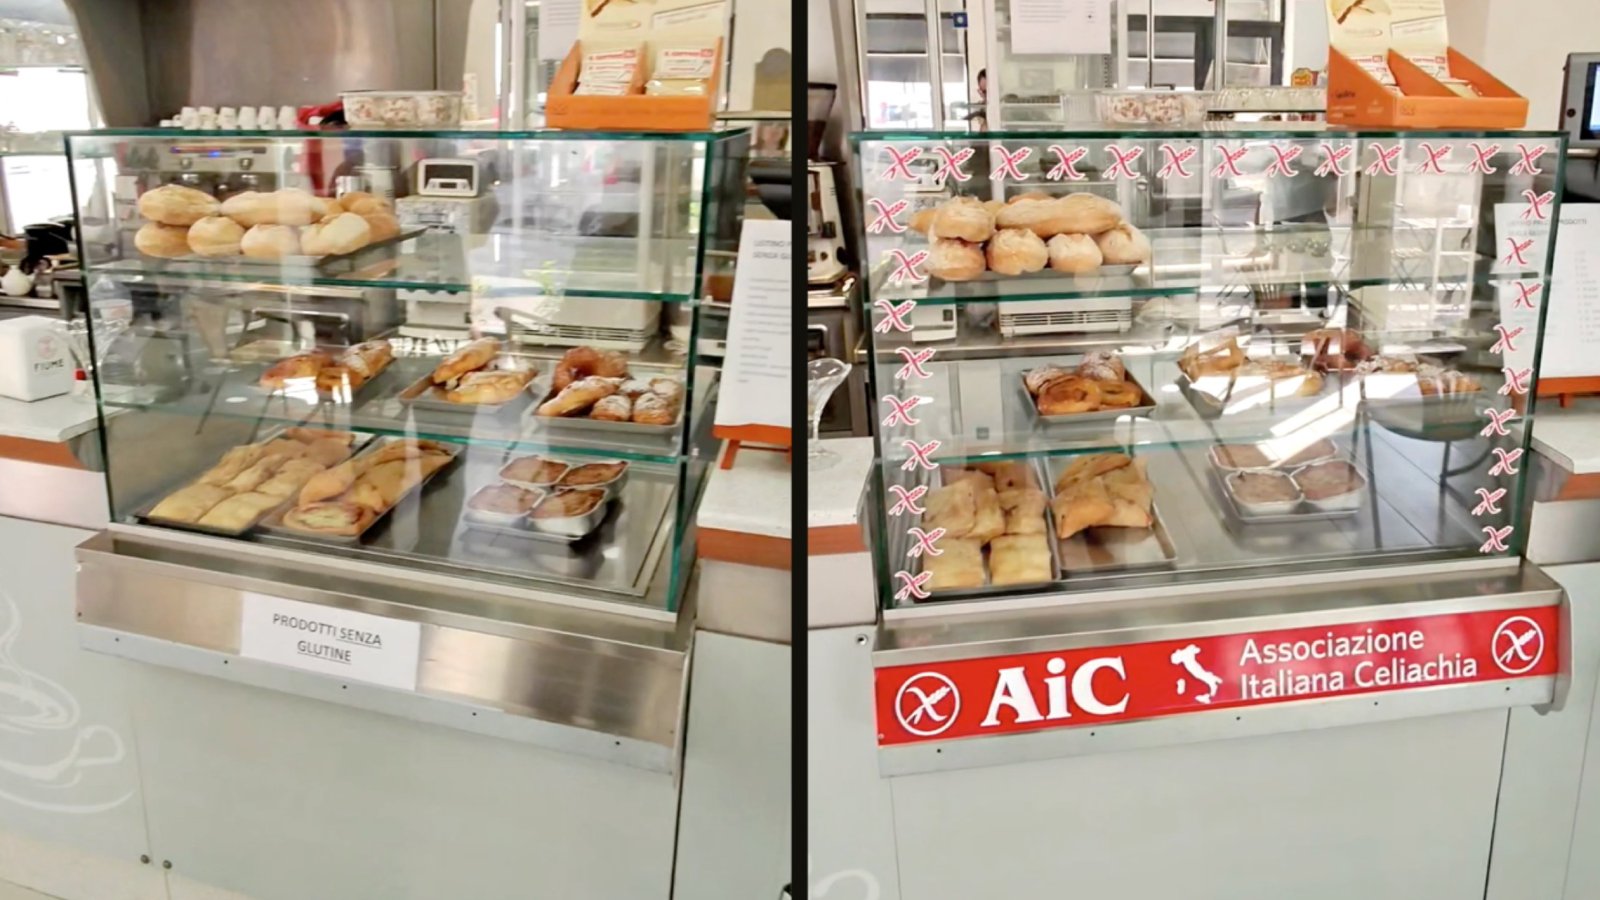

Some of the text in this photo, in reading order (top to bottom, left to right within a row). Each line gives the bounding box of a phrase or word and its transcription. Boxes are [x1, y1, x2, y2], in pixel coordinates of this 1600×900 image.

[272, 613, 383, 648] PRODOTTI SENZA
[1239, 628, 1425, 667] Associazione
[296, 640, 352, 663] GLUTINE
[980, 656, 1130, 727] AiC
[1240, 653, 1478, 700] Italiana Celiachia
